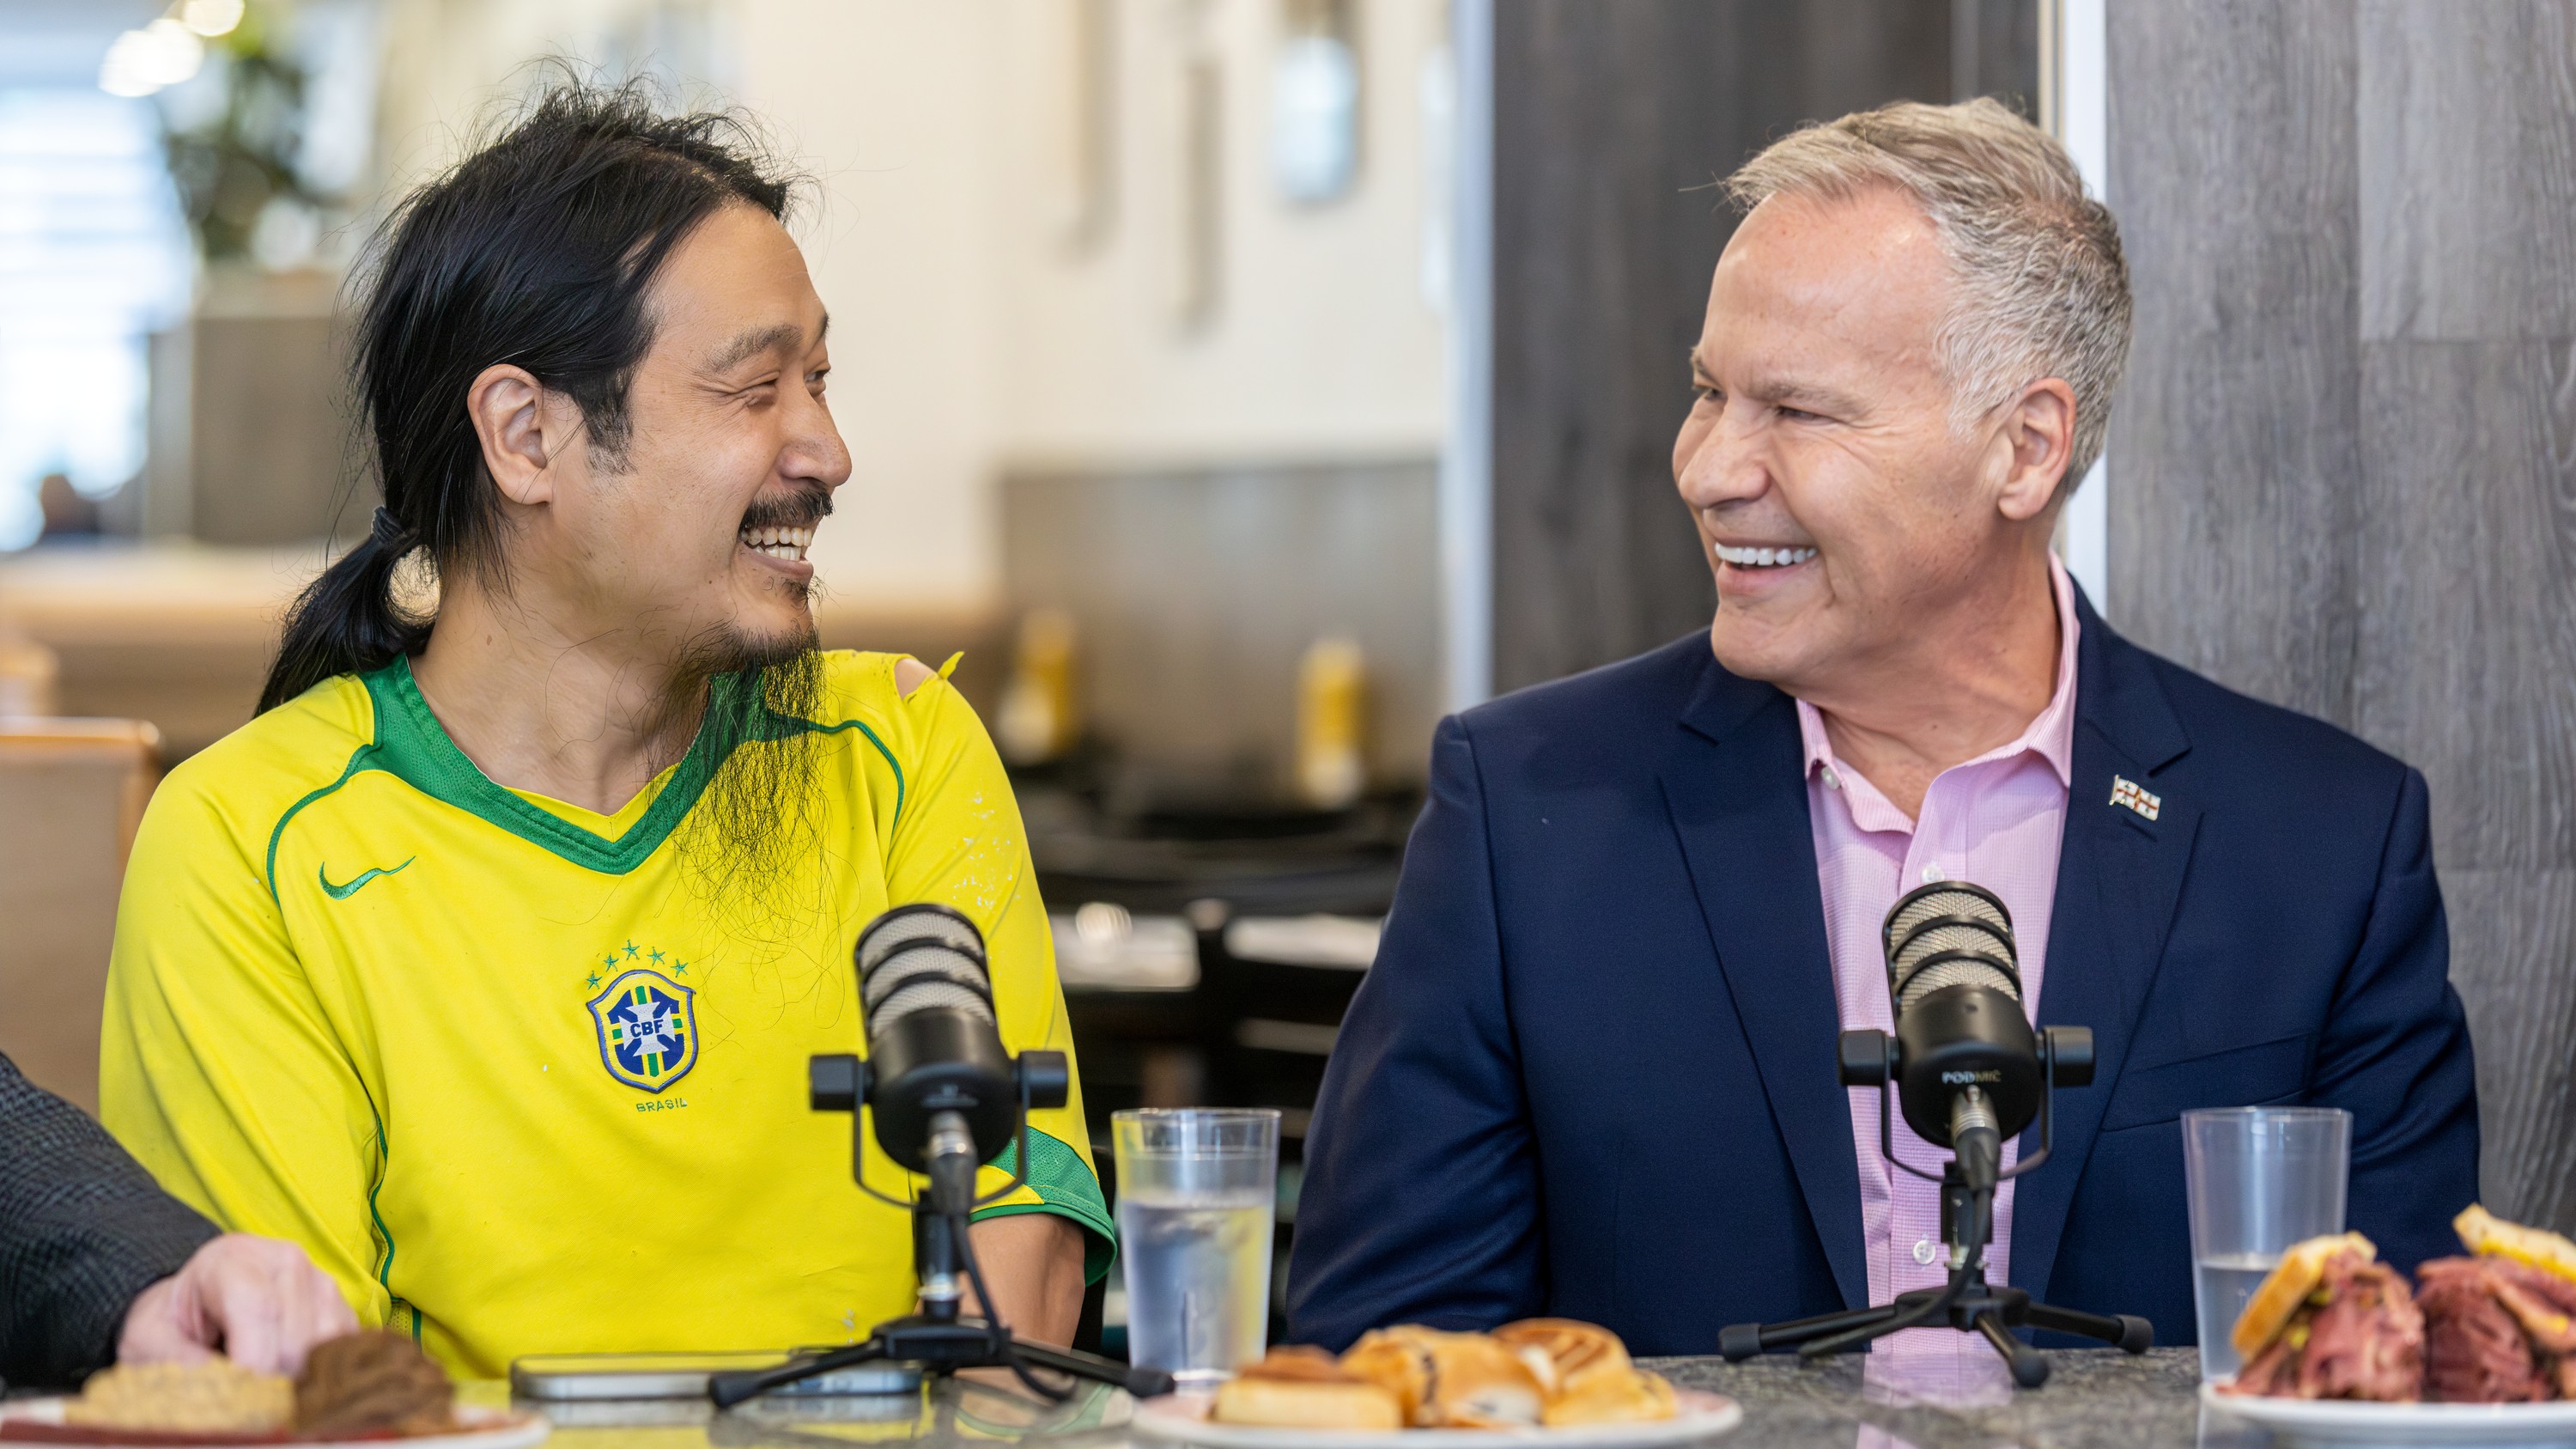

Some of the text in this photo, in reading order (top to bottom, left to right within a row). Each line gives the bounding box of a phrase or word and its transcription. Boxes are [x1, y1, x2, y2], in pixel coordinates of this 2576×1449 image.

[629, 1019, 664, 1038] CBF
[1941, 1069, 2002, 1084] PODMIC
[635, 1098, 687, 1112] BRASIL
